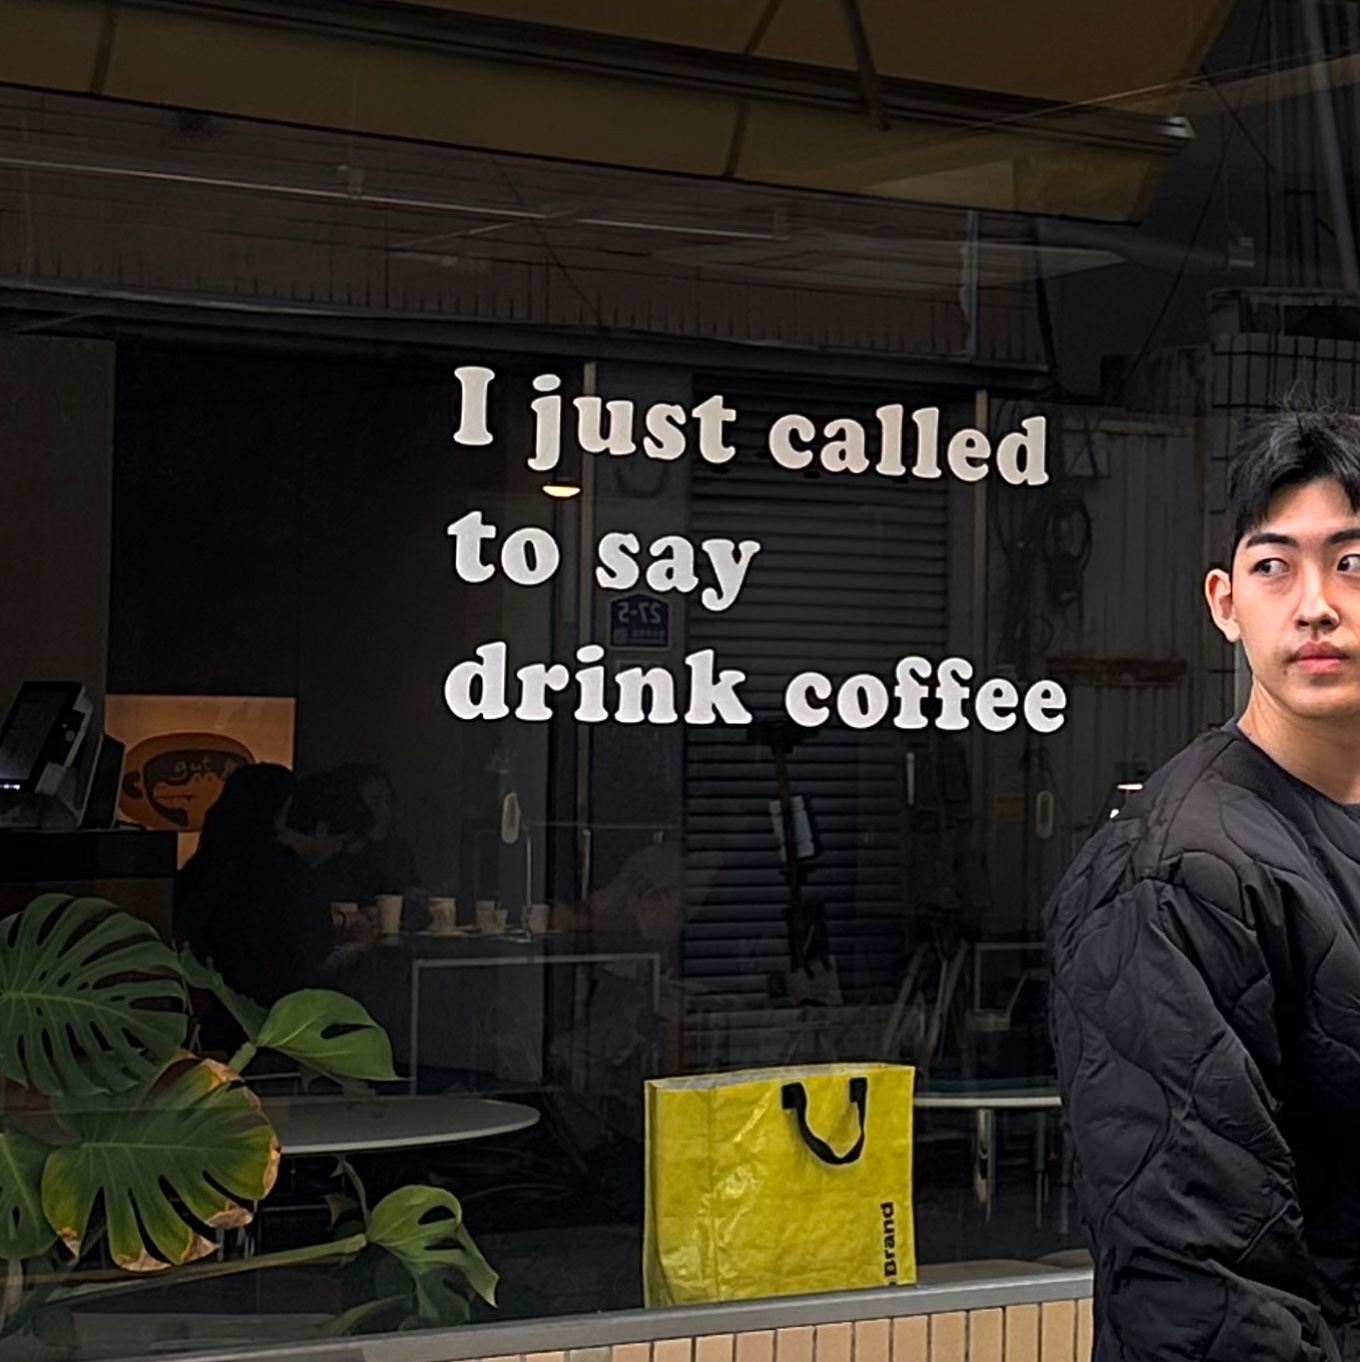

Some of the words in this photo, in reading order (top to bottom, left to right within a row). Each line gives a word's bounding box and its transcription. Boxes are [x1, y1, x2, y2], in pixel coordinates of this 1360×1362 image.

[453, 366, 495, 446] I
[527, 373, 736, 471] just
[768, 403, 1050, 486] called
[447, 510, 560, 585] to
[595, 531, 761, 612] say
[444, 641, 753, 725] drink
[784, 656, 1067, 733] coffee
[880, 1202, 897, 1277] Brand
